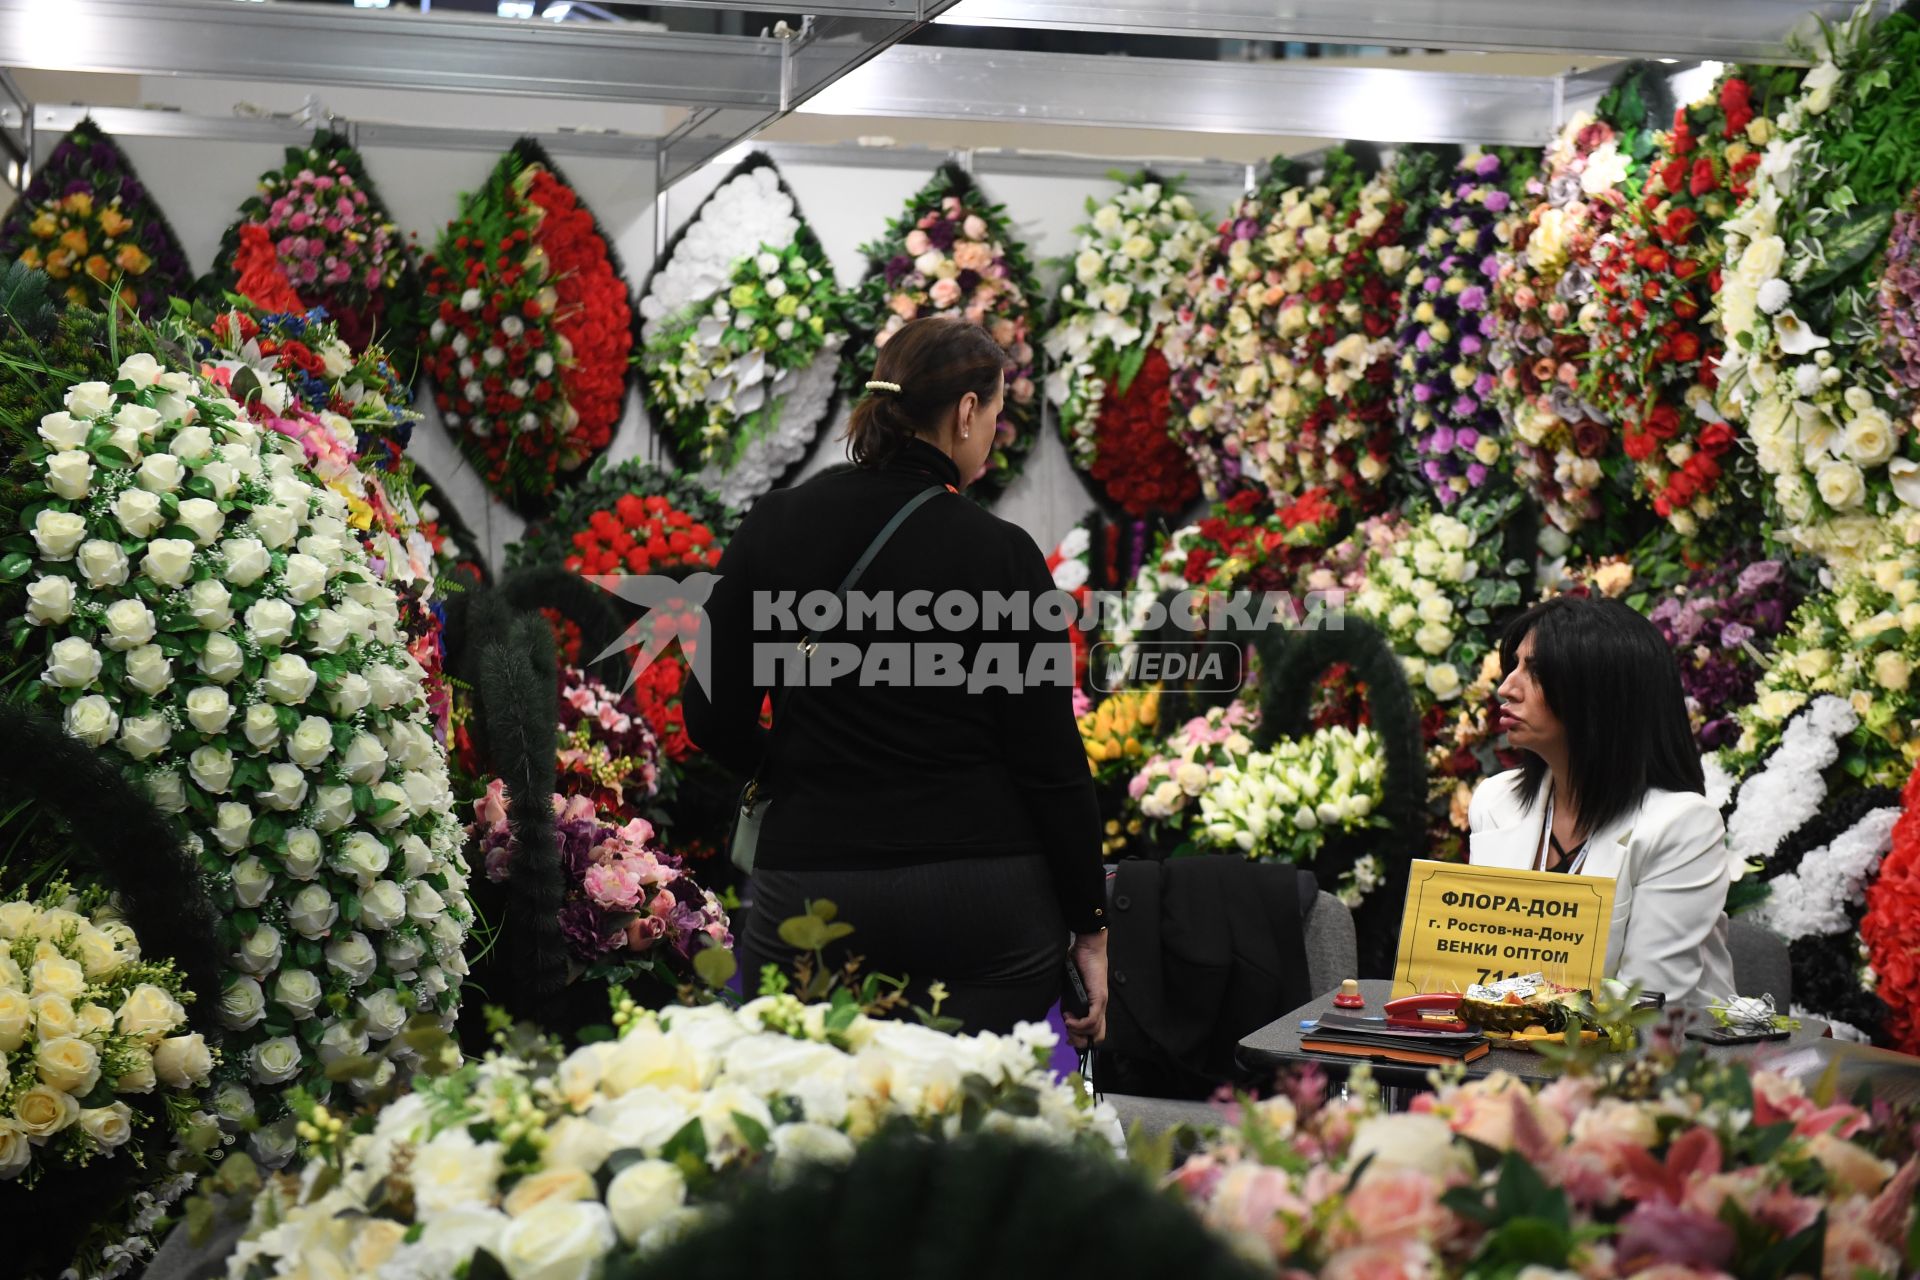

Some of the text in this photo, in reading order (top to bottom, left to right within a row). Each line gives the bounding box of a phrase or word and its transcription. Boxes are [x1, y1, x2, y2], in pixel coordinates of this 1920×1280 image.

[1441, 891, 1579, 918] ФЛОРА-ДОН
[1428, 918, 1585, 945] г. Ростов-на-Дону
[1436, 939, 1569, 964] ВЕНКИ ОПТОМ
